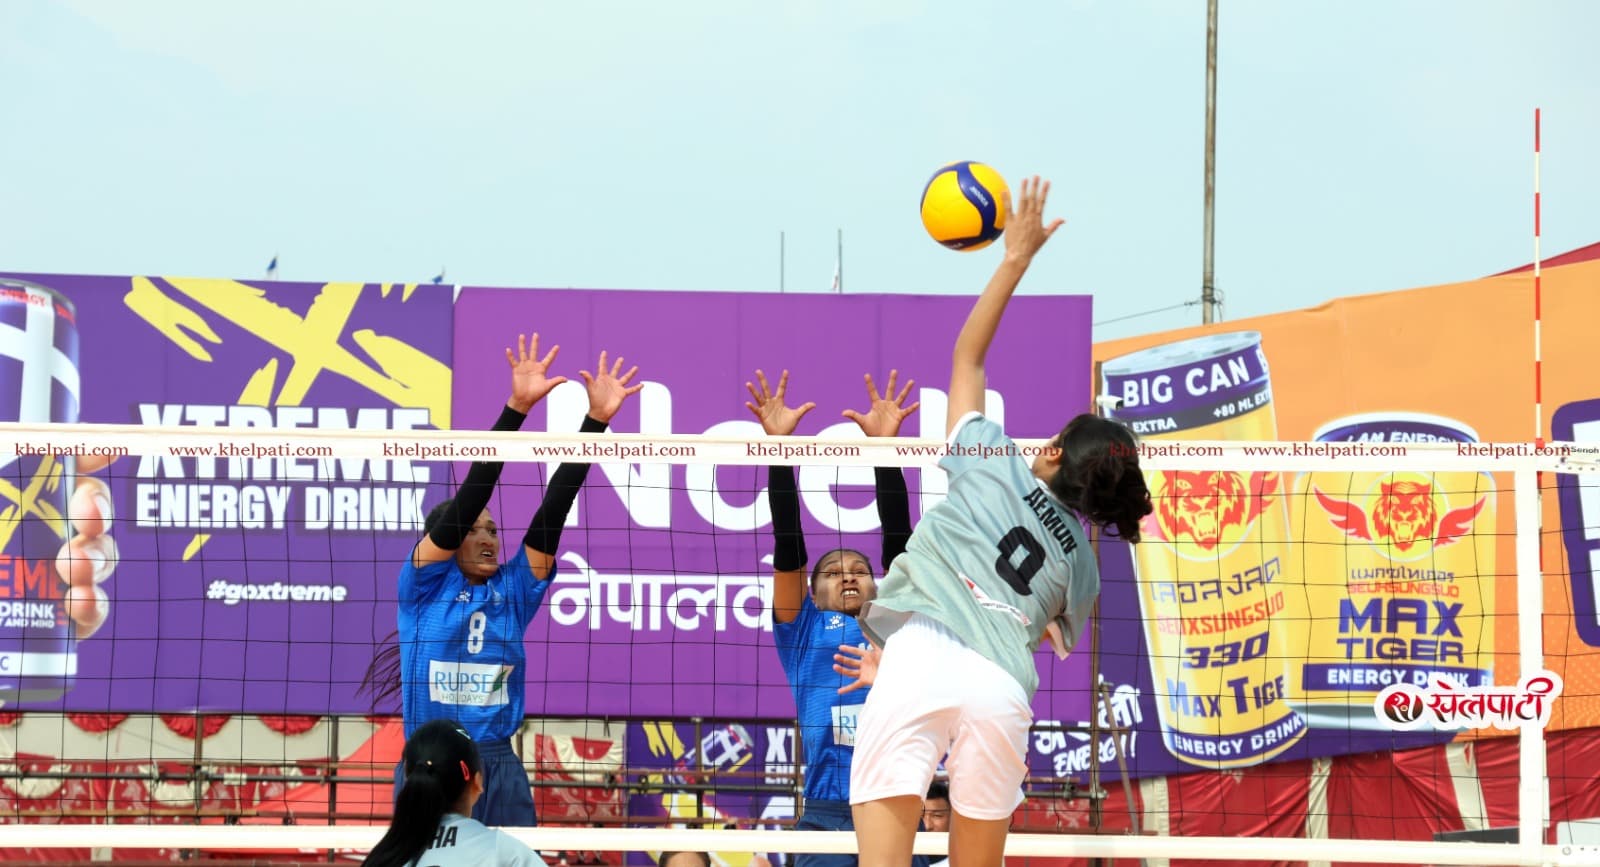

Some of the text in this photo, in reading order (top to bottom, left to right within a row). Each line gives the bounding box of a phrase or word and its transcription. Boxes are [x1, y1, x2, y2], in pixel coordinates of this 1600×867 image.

[1123, 375, 1174, 407] BIG
[1185, 356, 1251, 396] CAN
[1133, 417, 1177, 433] EXTRA
[1213, 404, 1236, 419] +80
[137, 403, 431, 484] XTREME
[137, 484, 426, 531] ENERGY DRINK
[206, 580, 347, 605] #goxtreme
[0, 601, 55, 619] DRINK
[1338, 597, 1465, 638] MAX
[467, 611, 487, 654] 8
[1183, 631, 1270, 669] 330
[1336, 637, 1465, 664] TIGER
[434, 671, 495, 694] RUPSE
[1327, 668, 1407, 685] ENERGY
[1174, 711, 1304, 756] ENERGY DRINK
[427, 826, 458, 850] HA
